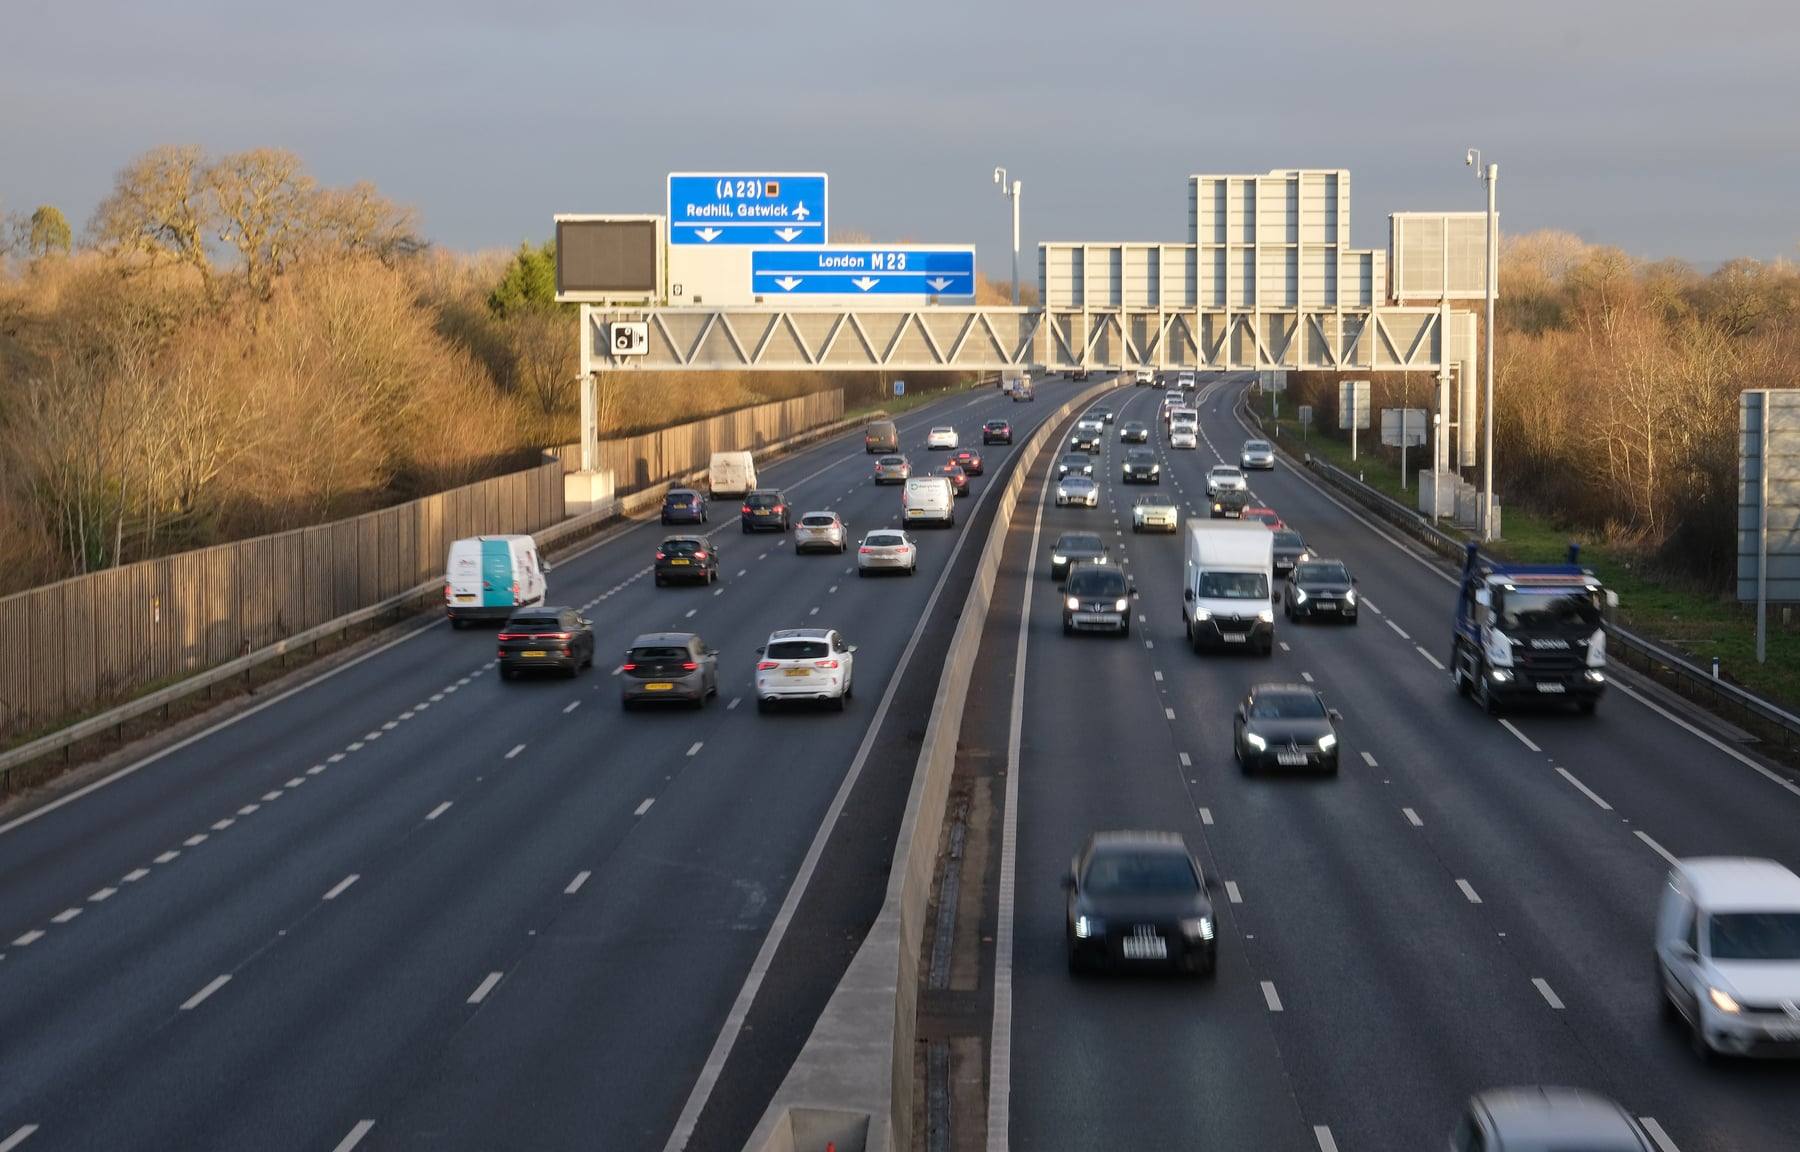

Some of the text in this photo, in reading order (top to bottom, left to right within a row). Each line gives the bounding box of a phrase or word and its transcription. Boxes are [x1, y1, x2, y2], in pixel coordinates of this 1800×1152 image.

[687, 203, 788, 218] Redhill, Gatwick
[819, 254, 864, 267] London
